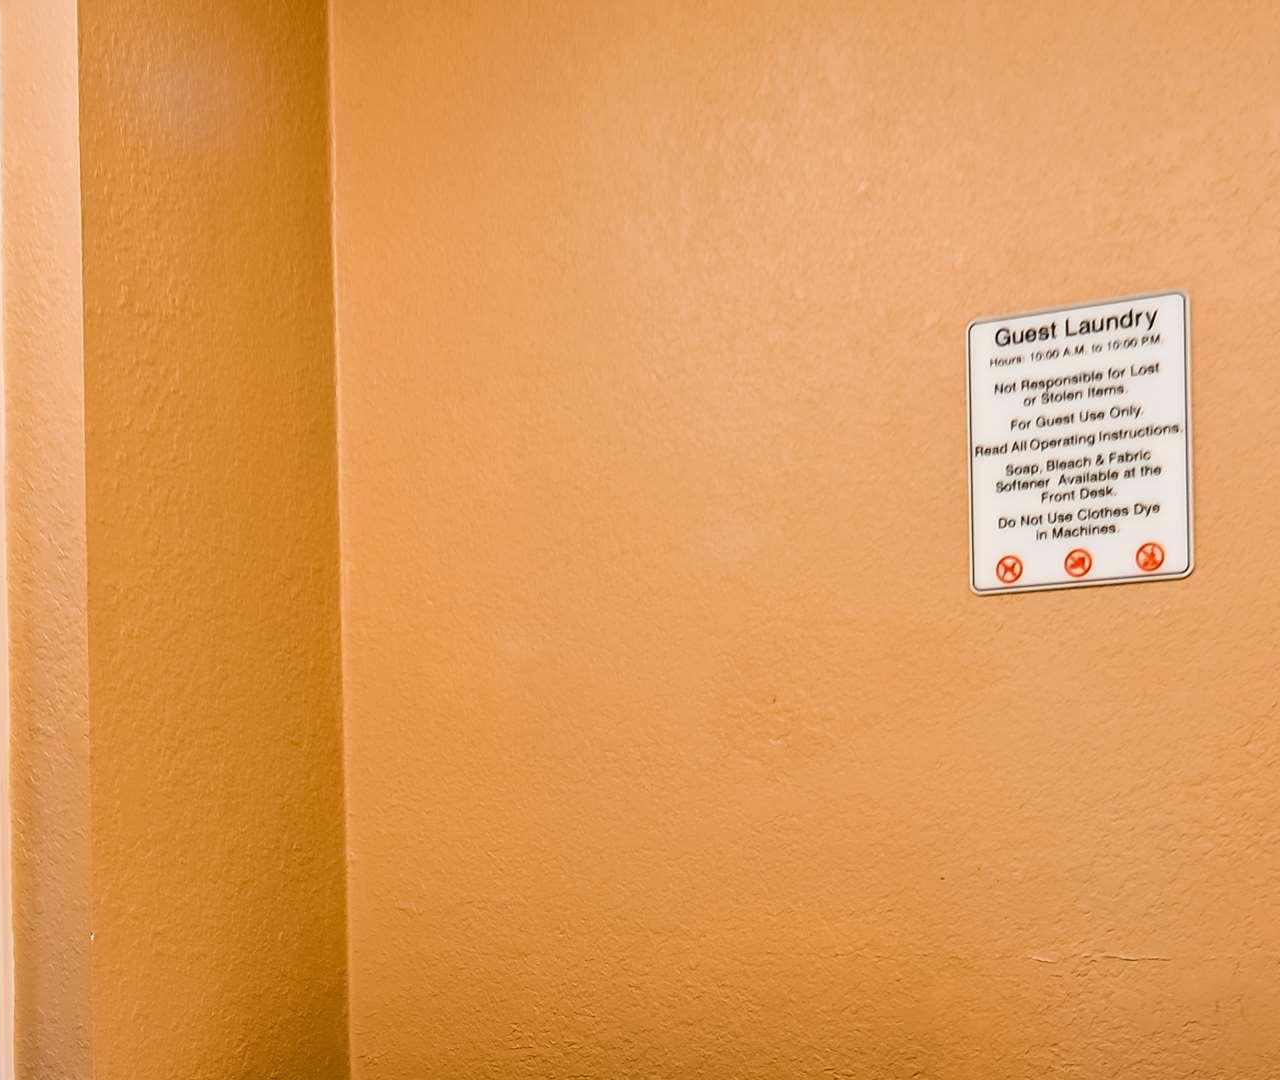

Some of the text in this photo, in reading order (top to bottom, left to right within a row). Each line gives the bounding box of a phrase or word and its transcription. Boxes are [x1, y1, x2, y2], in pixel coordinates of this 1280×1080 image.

[995, 309, 1158, 347] Guest Laundry
[990, 356, 1024, 368] Hours:
[1031, 351, 1060, 362] 10:00
[1092, 344, 1102, 354] to
[1108, 339, 1137, 350] 10:00
[994, 362, 1160, 395] Not Responsible for Lost
[1024, 385, 1128, 407] or Stolen Items.
[1010, 405, 1144, 431] For Guest Use Only.
[974, 423, 1183, 458] Read All Operating Instructions.
[1006, 449, 1151, 478] Soap, Bleach & Fabric
[995, 464, 1162, 493] Softener Available at the
[1041, 486, 1118, 504] Front Desk.
[998, 502, 1161, 529] Do Not Use Clothes Dye
[1036, 523, 1120, 541] in Machines.
